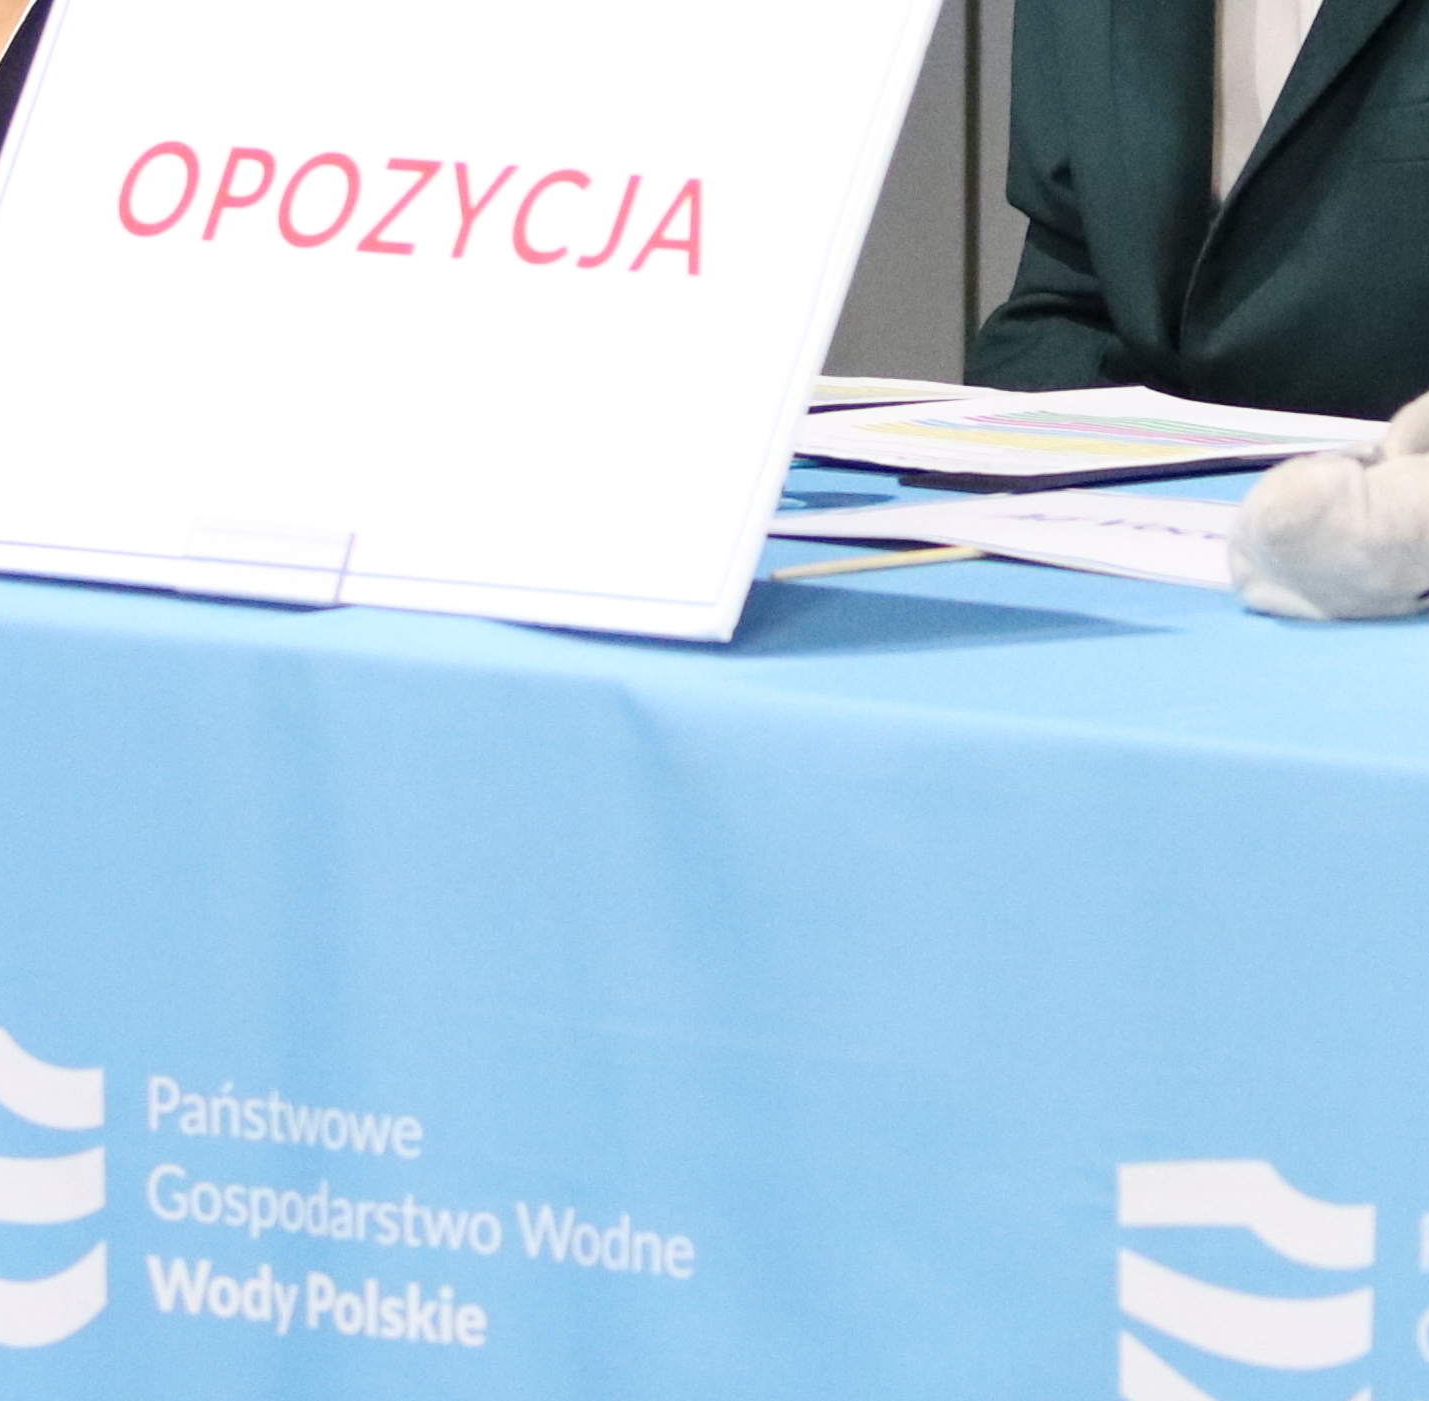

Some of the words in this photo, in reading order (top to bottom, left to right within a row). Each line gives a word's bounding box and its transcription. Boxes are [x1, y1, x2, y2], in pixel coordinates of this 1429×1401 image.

[119, 141, 701, 276] OPOZYCJA
[147, 1074, 424, 1159] Państwowe
[146, 1163, 504, 1255] Gospodarstwo
[515, 1202, 697, 1279] Wodne
[146, 1255, 300, 1335] Wody
[305, 1274, 489, 1348] Polskie
